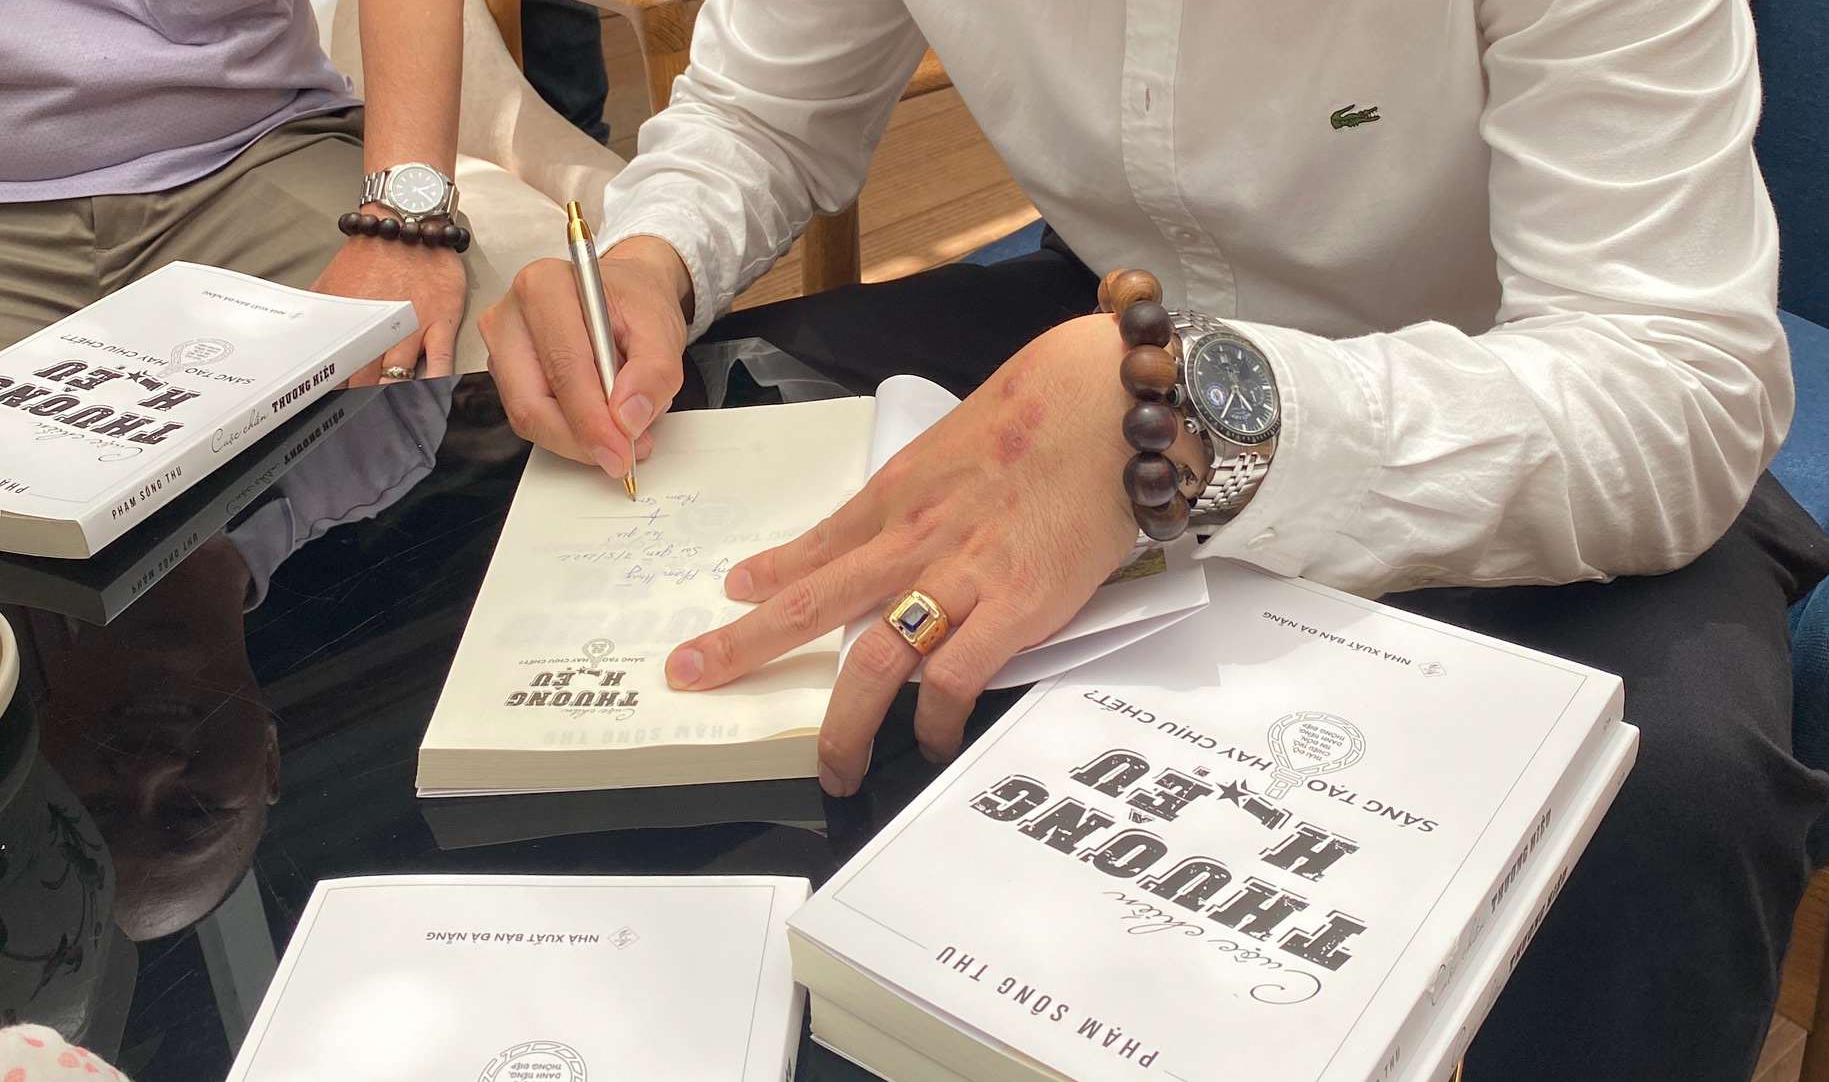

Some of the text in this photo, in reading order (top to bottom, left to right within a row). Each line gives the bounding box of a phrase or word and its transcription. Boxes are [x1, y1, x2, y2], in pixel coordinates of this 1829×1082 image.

[146, 355, 170, 368] HAY
[138, 479, 163, 501] SÔNG
[164, 465, 182, 484] THU
[1300, 624, 1318, 635] ĐÀ
[1318, 631, 1346, 645] BẢN
[1346, 641, 1382, 656] XUẤT
[1383, 651, 1412, 666] NHÀ
[1319, 729, 1345, 741] THÔNG
[1320, 736, 1343, 747] DANH
[1082, 689, 1440, 834] SÁNG TẠO HAY CHỊU CHẾT?
[968, 774, 1369, 973] THƯƠNG
[425, 931, 600, 946] NHÀ XUẤT BẢN ĐÀ NẴNG
[1102, 891, 1323, 1005] Cuộc chiến
[935, 946, 1160, 1068] PHẠM SÔNG THU
[510, 1062, 562, 1071] THÔNG ĐIỆP
[535, 1071, 562, 1080] DANH
